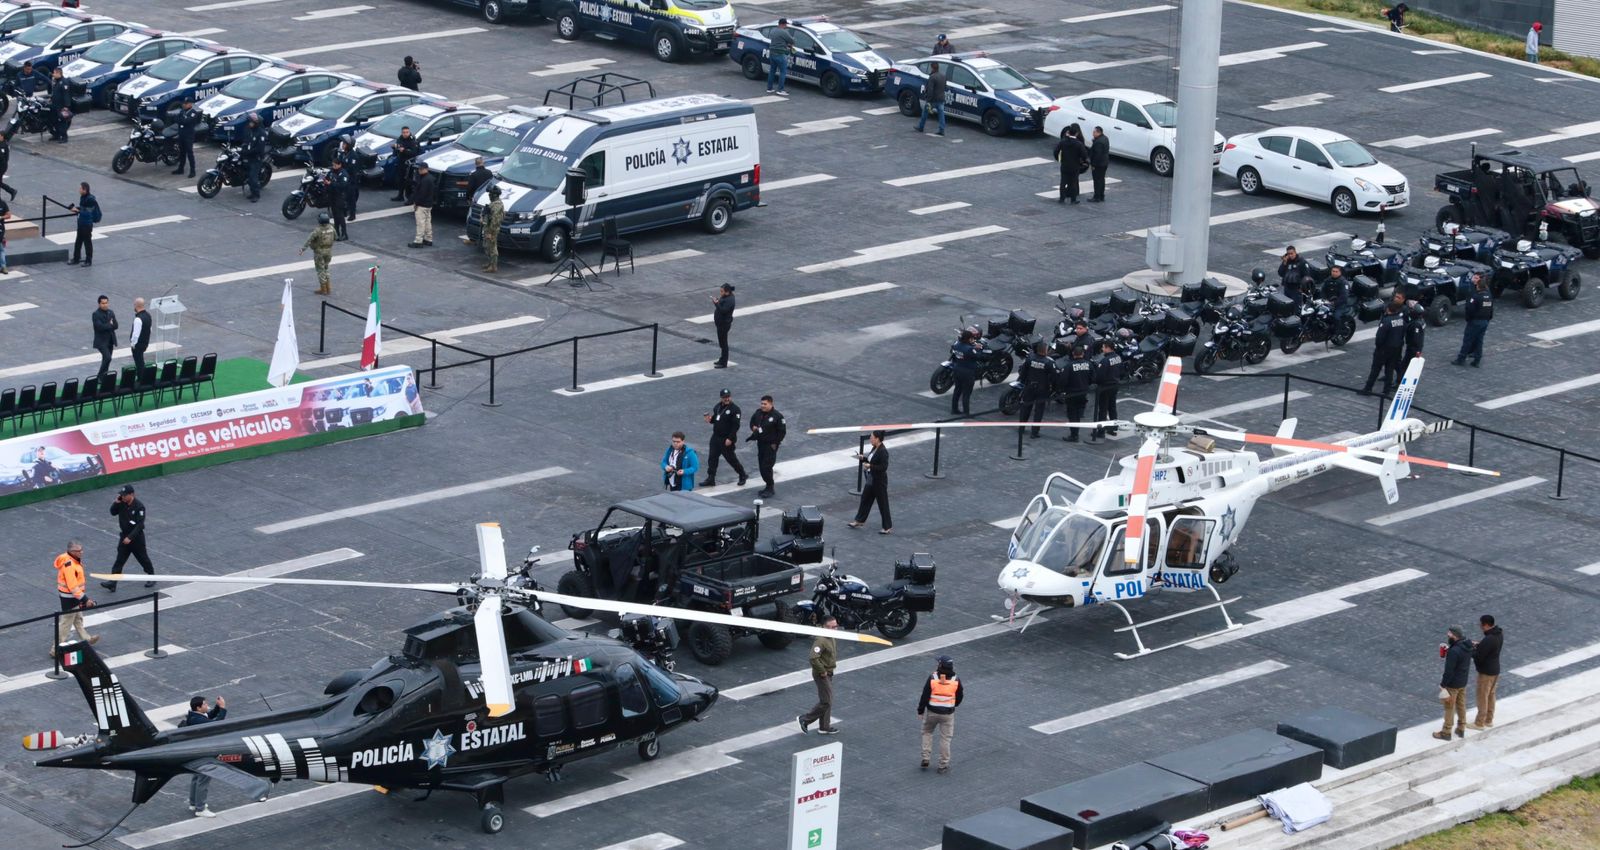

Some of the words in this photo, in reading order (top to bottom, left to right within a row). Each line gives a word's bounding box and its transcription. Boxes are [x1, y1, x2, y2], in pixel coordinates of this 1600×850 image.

[579, 1, 599, 17] POLICÍA
[612, 9, 633, 26] ESTATAL
[795, 57, 817, 70] MUNICIPAL
[955, 94, 978, 108] MUNICIPAL
[272, 105, 297, 120] POLICÍA
[625, 147, 666, 172] POLICÍA
[698, 135, 739, 157] ESTATAL
[149, 417, 177, 428] Seguridad
[108, 436, 181, 463] Entrega
[183, 429, 207, 448] de
[1161, 572, 1206, 589] STATAL
[351, 740, 414, 769] POLICÍA
[461, 722, 527, 751] ESTATAL
[812, 753, 835, 765] PUEBLA
[801, 789, 834, 803] SALIDA
